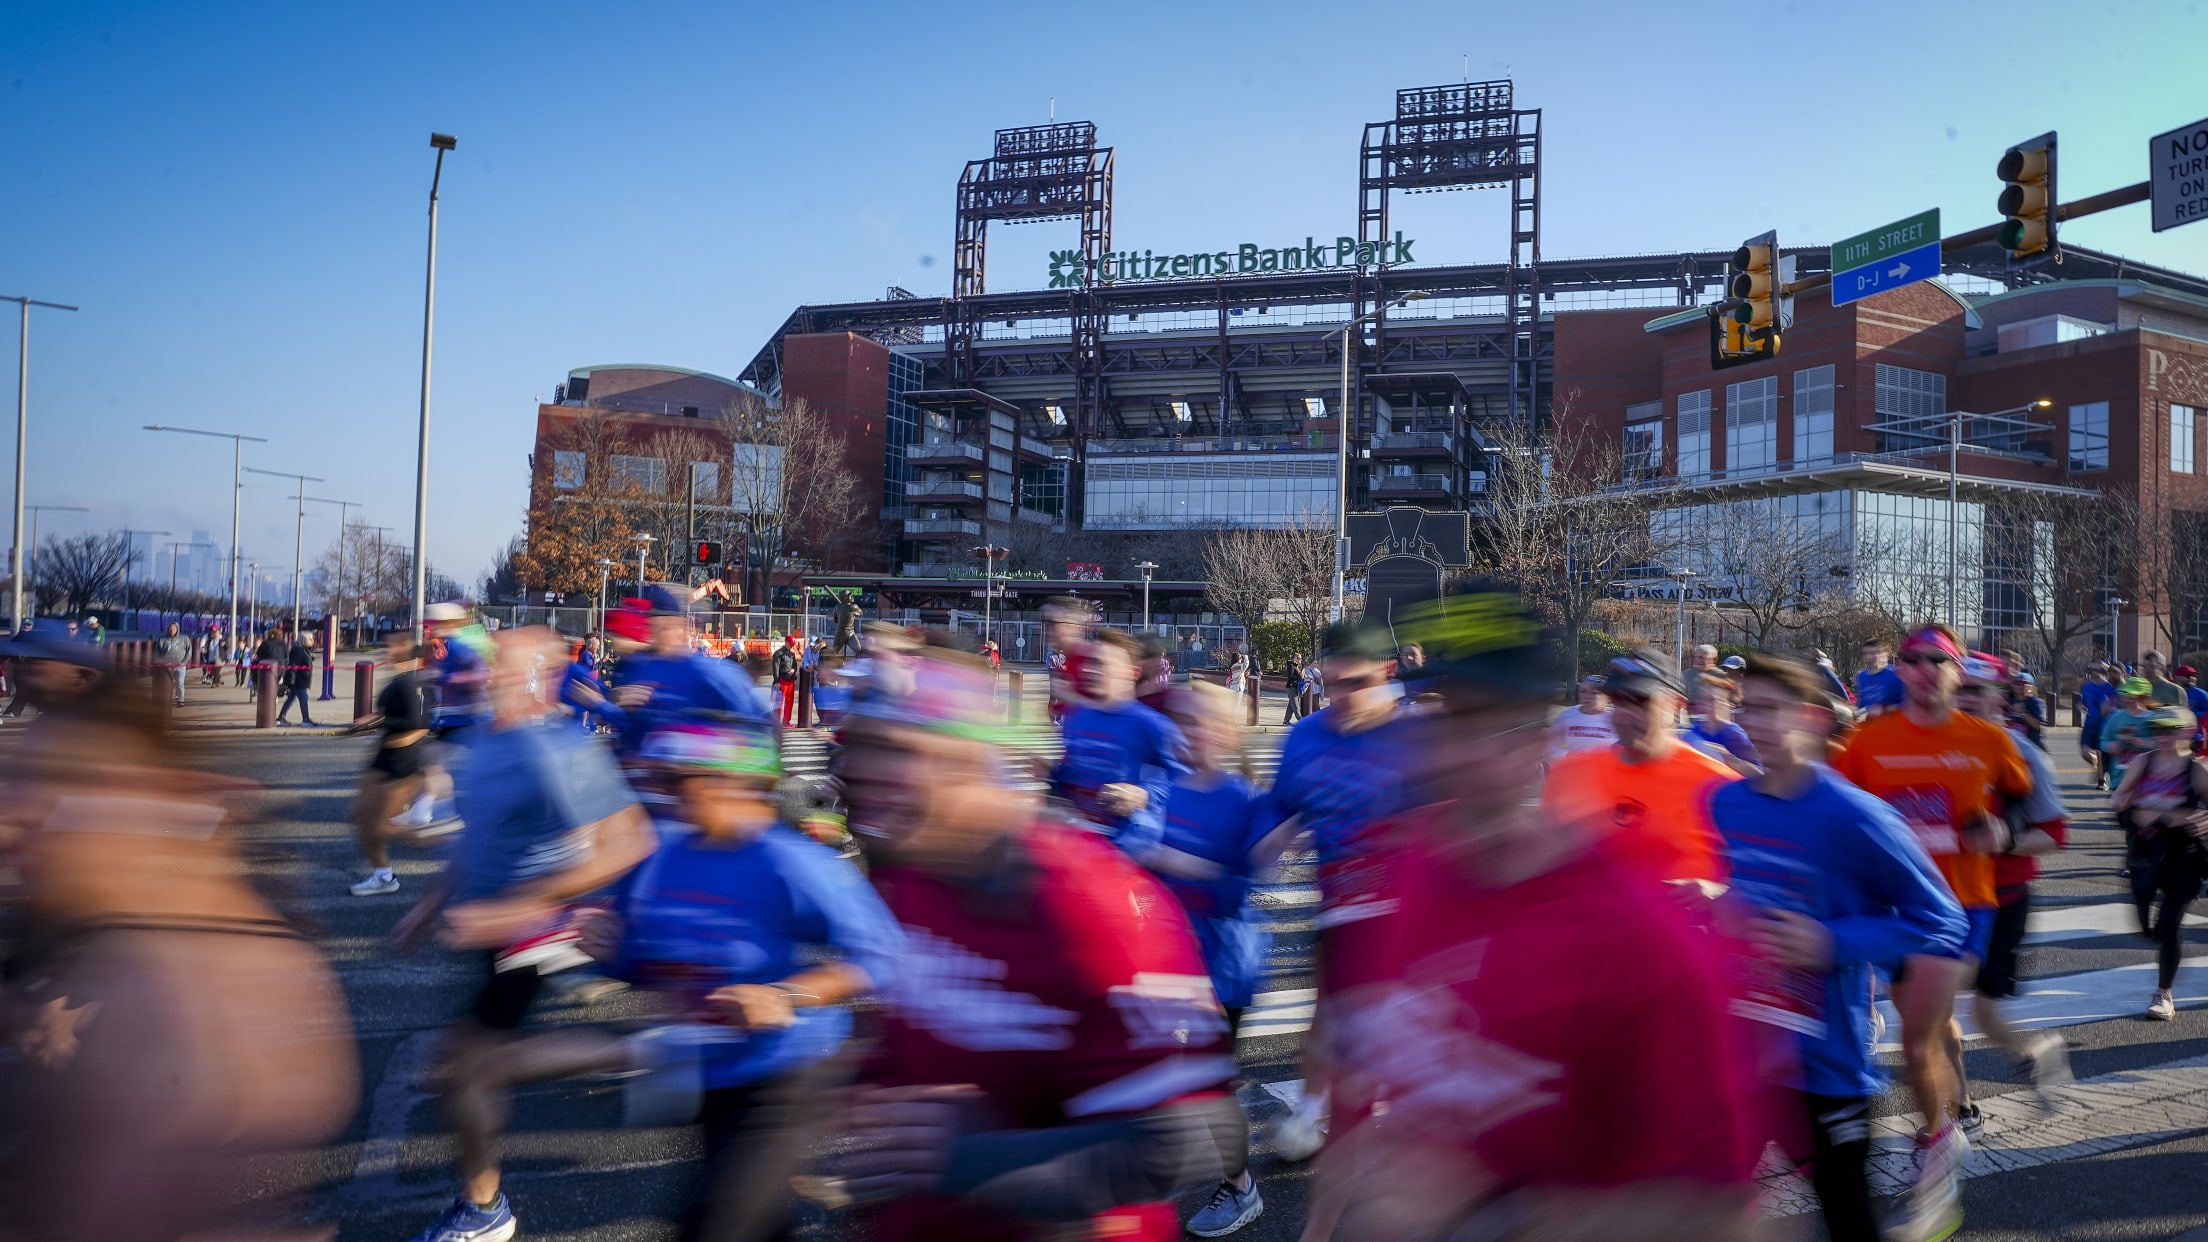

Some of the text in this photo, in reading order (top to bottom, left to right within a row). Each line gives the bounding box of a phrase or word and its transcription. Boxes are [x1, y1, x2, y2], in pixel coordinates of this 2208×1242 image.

[2171, 129, 2208, 160] NO
[2180, 177, 2205, 197] ON
[2175, 197, 2208, 221] RED
[1845, 223, 1924, 262] 11TH STREET
[1097, 230, 1416, 281] Citizens Bank Park
[1857, 270, 1879, 291] D-J
[970, 590, 987, 598] THIRD
[1637, 587, 1664, 599] PASS
